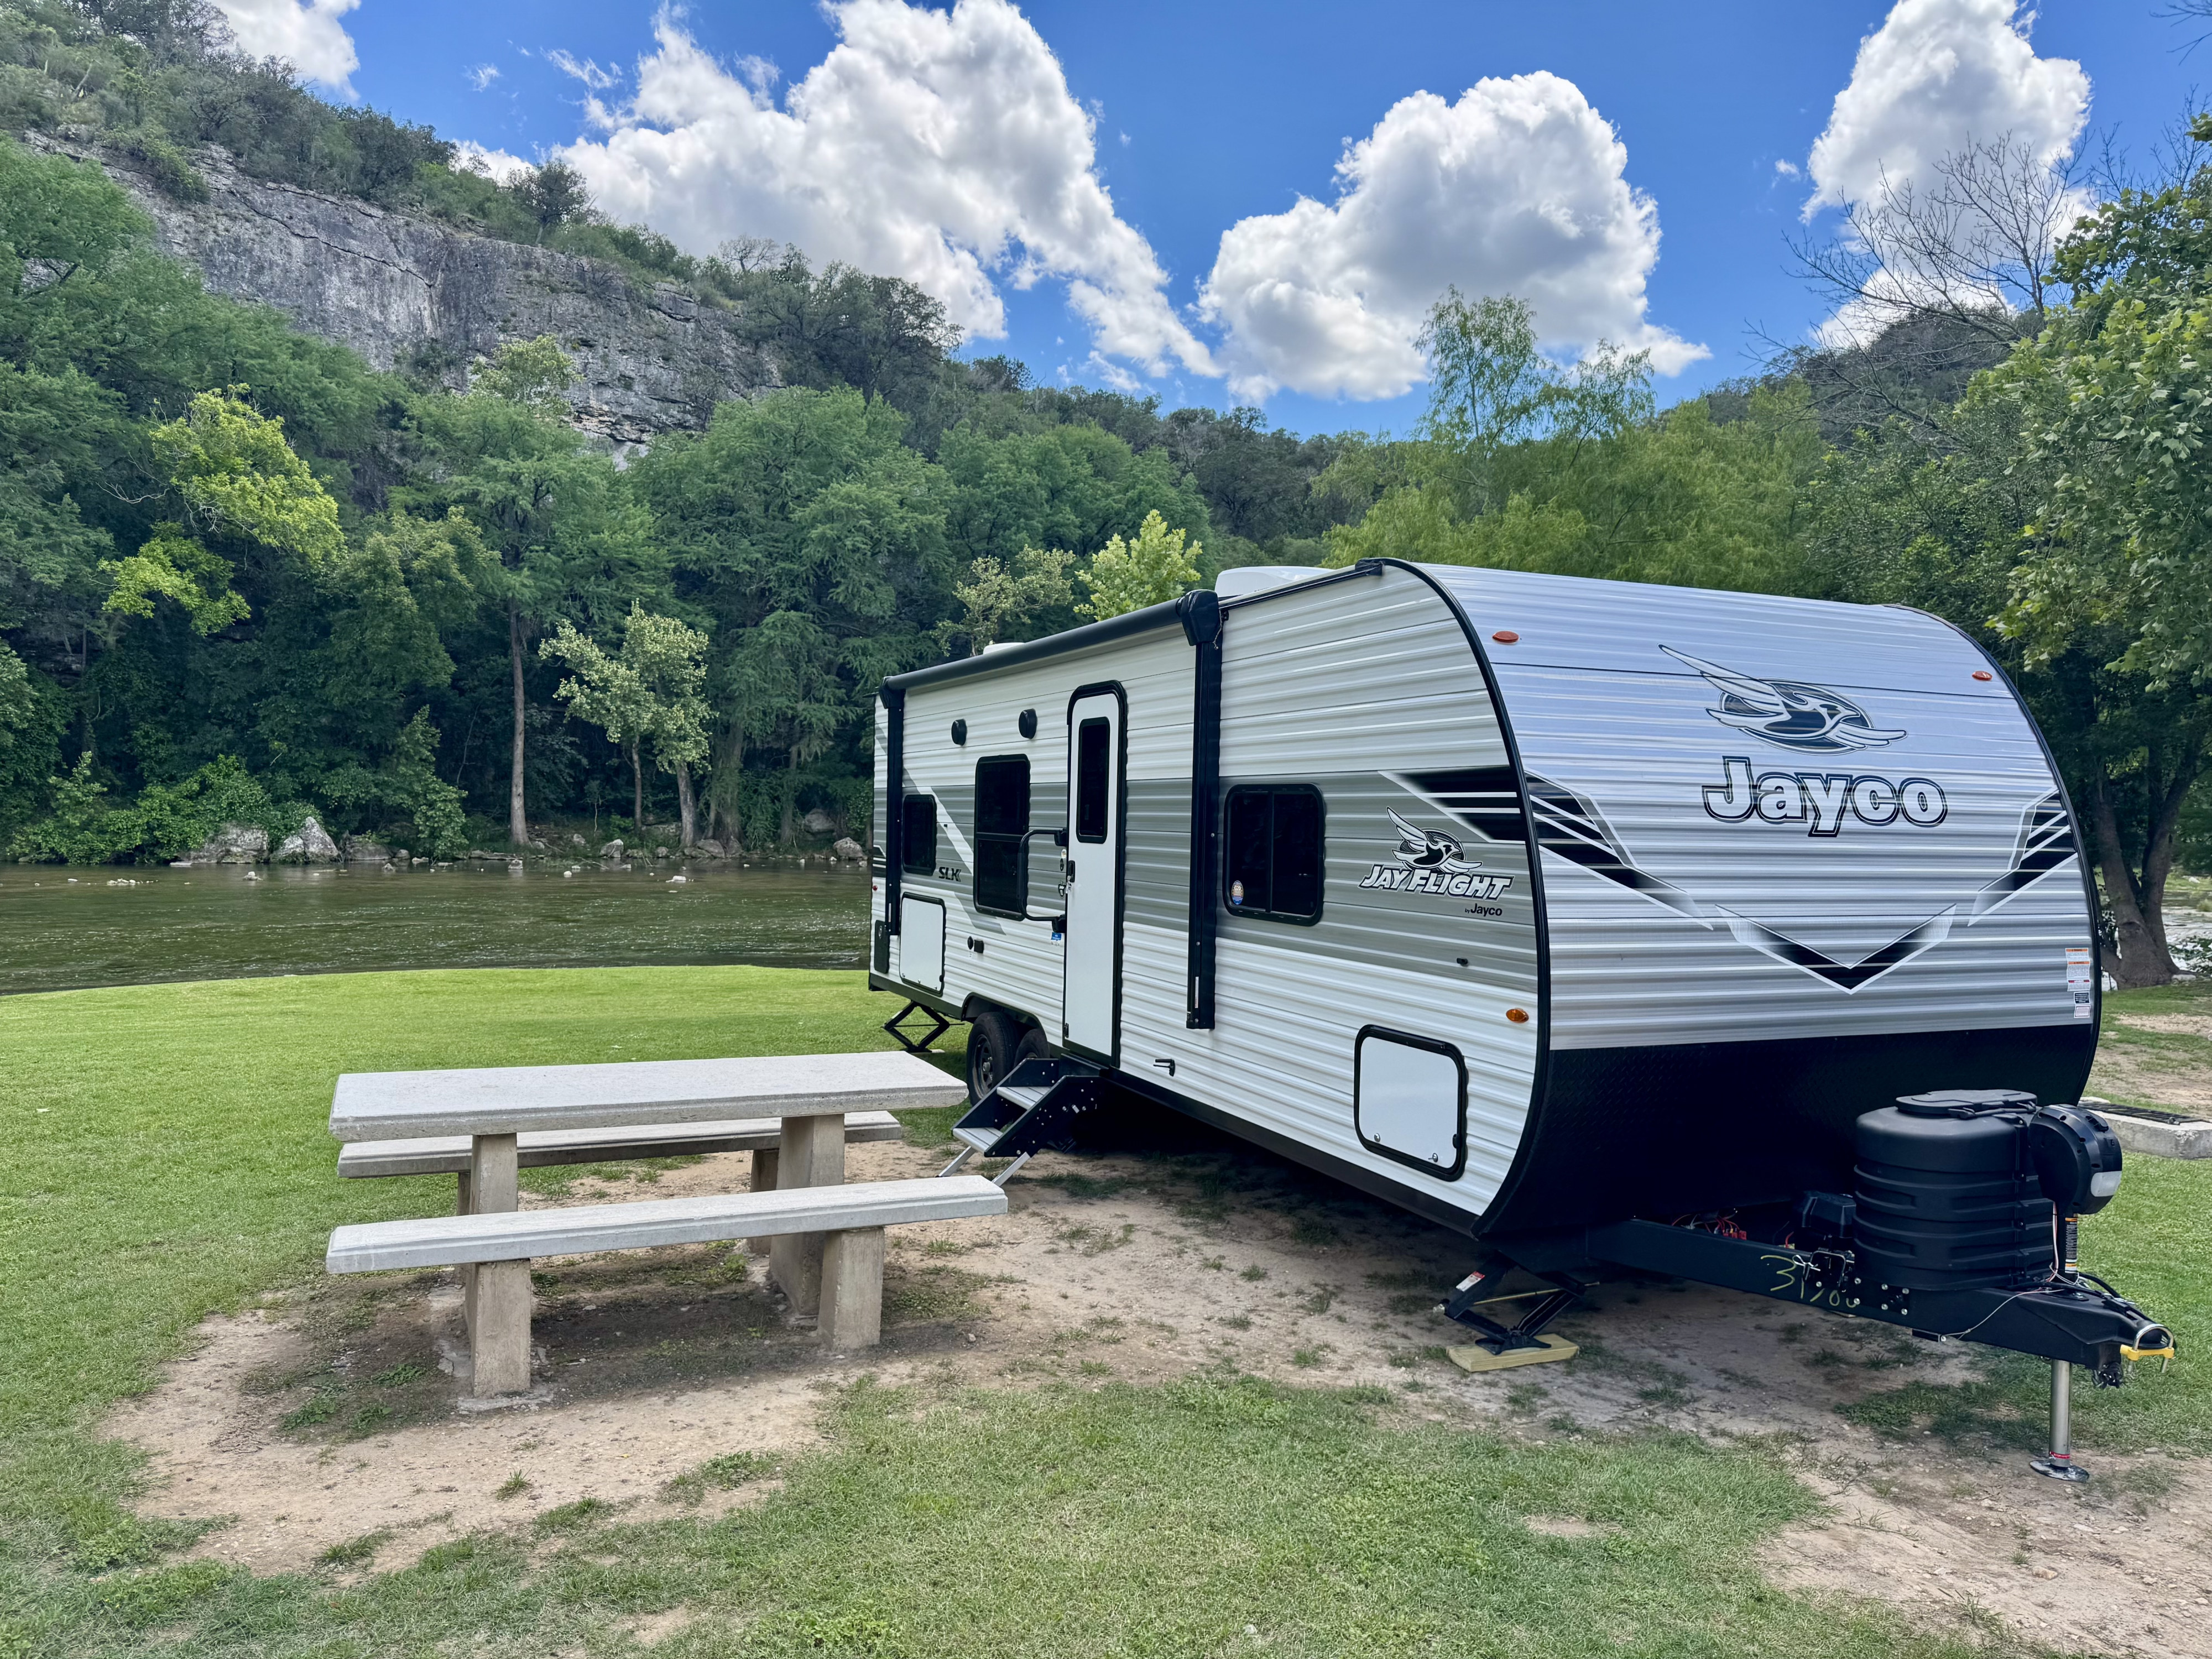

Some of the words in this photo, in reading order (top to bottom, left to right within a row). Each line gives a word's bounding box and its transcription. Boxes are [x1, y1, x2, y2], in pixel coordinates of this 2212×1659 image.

[1702, 755, 1948, 837] Jayco
[938, 867, 961, 882] SLK
[1358, 864, 1412, 891] JAY
[1404, 868, 1514, 901] FLIGHT
[1470, 903, 1503, 917] Jayco
